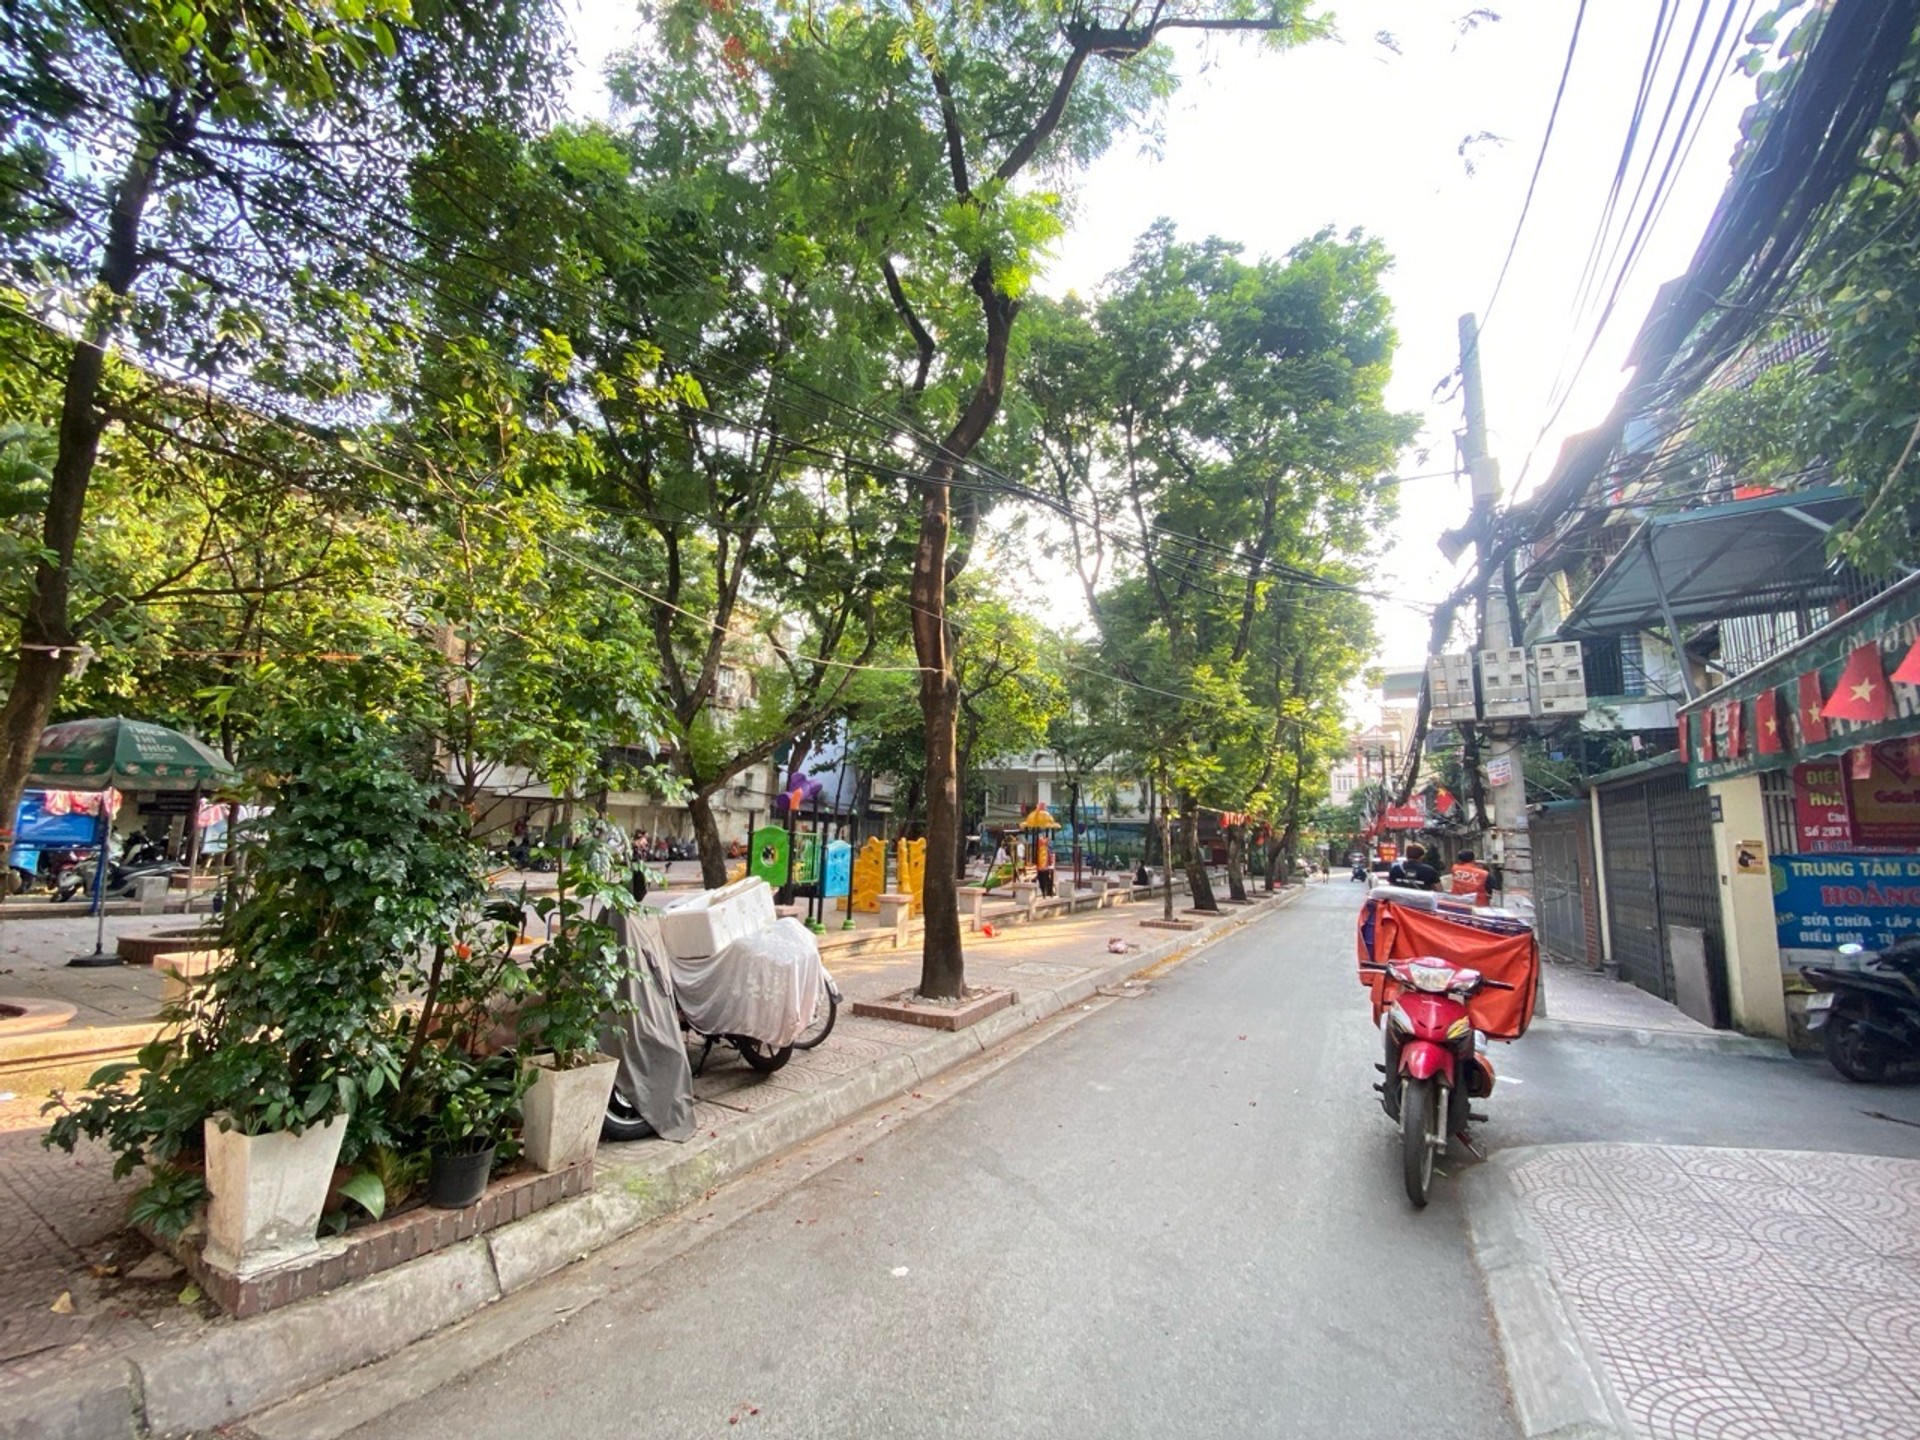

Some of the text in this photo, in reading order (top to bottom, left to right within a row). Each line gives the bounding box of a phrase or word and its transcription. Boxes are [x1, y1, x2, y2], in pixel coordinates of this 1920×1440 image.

[1790, 862, 1855, 876] TRUNG
[1860, 858, 1901, 876] TÂM
[1453, 870, 1479, 886] SPX
[1802, 911, 1830, 927] SỬA
[1834, 913, 1872, 927] CHỮA
